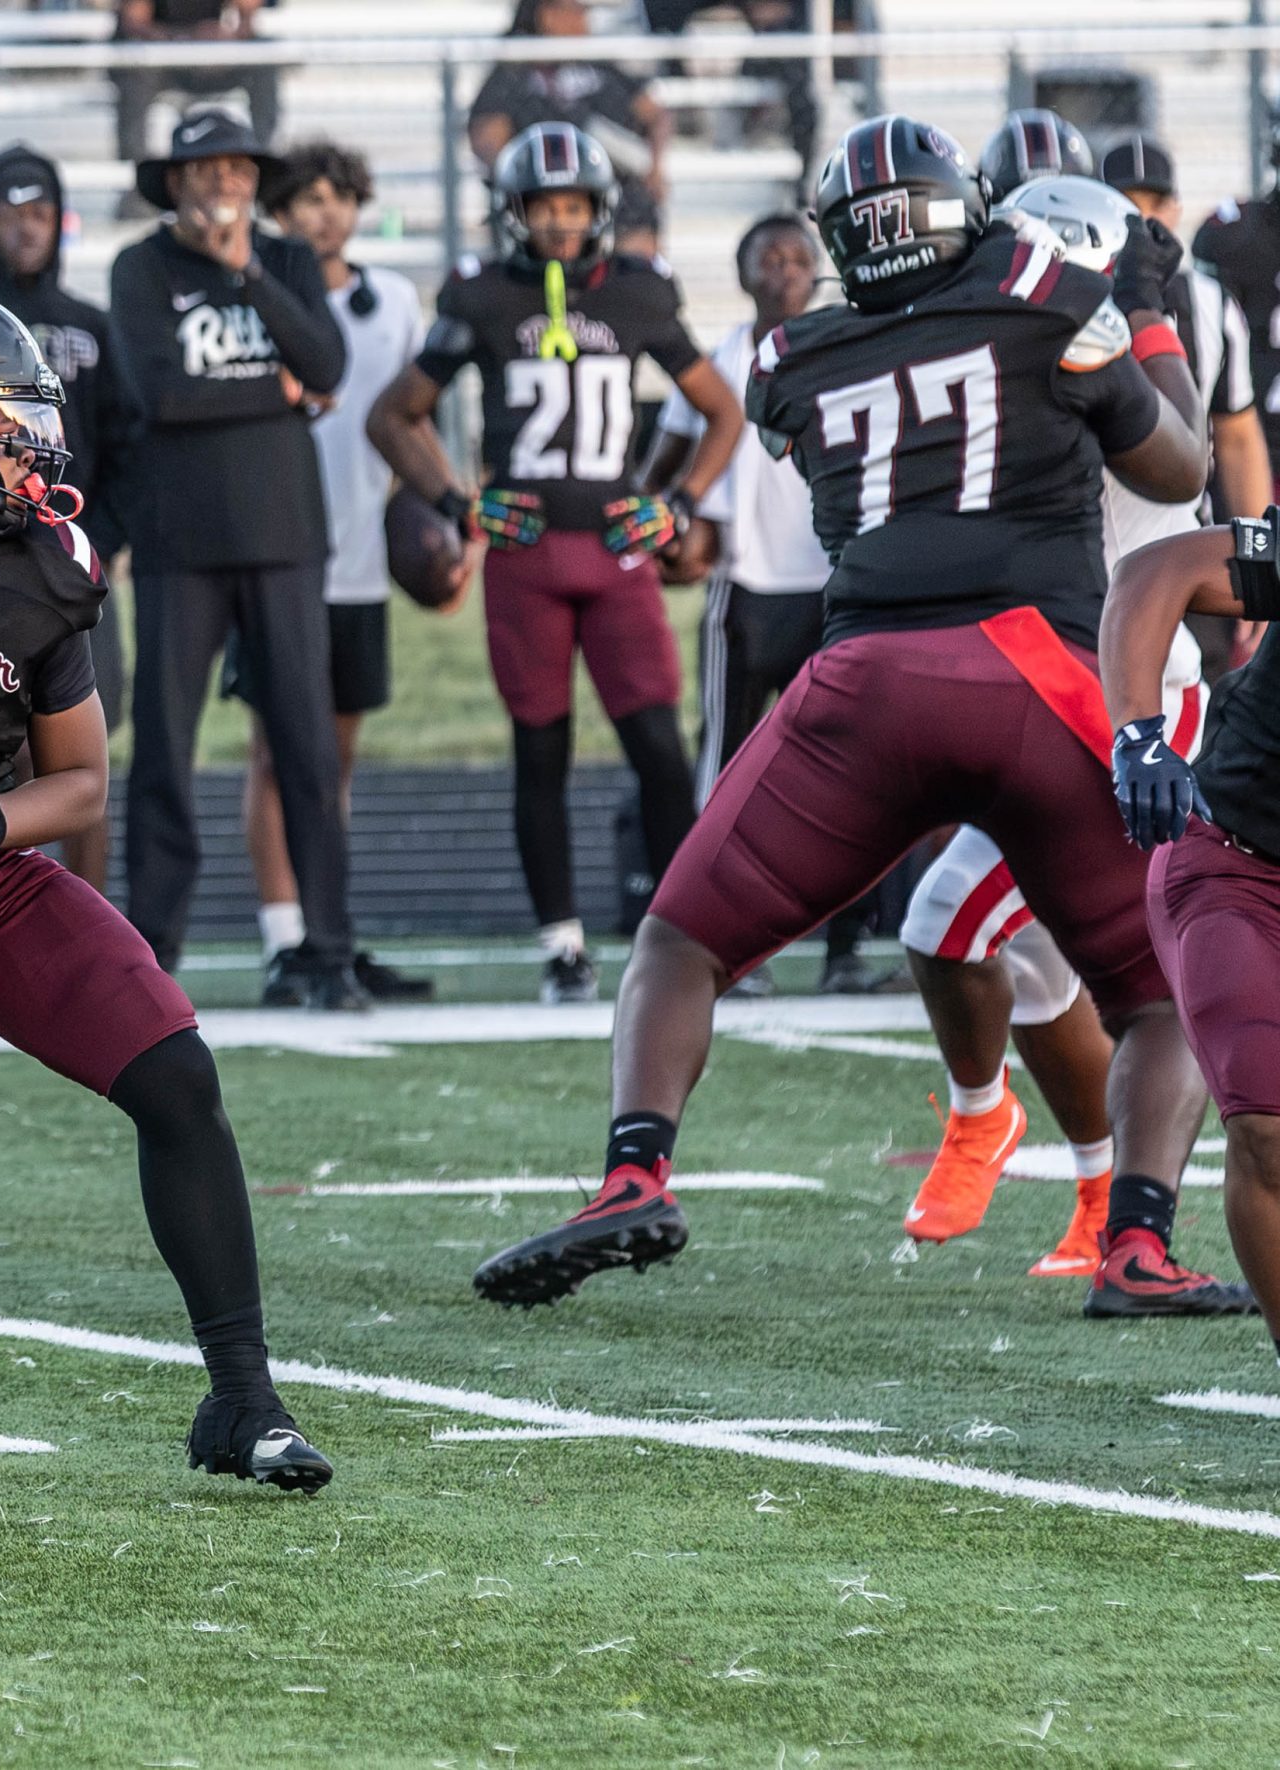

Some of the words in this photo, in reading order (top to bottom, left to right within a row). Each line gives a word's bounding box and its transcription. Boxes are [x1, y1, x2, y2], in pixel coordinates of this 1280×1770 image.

[850, 188, 915, 253] 77
[504, 354, 633, 481] 20
[817, 342, 1002, 535] 77
